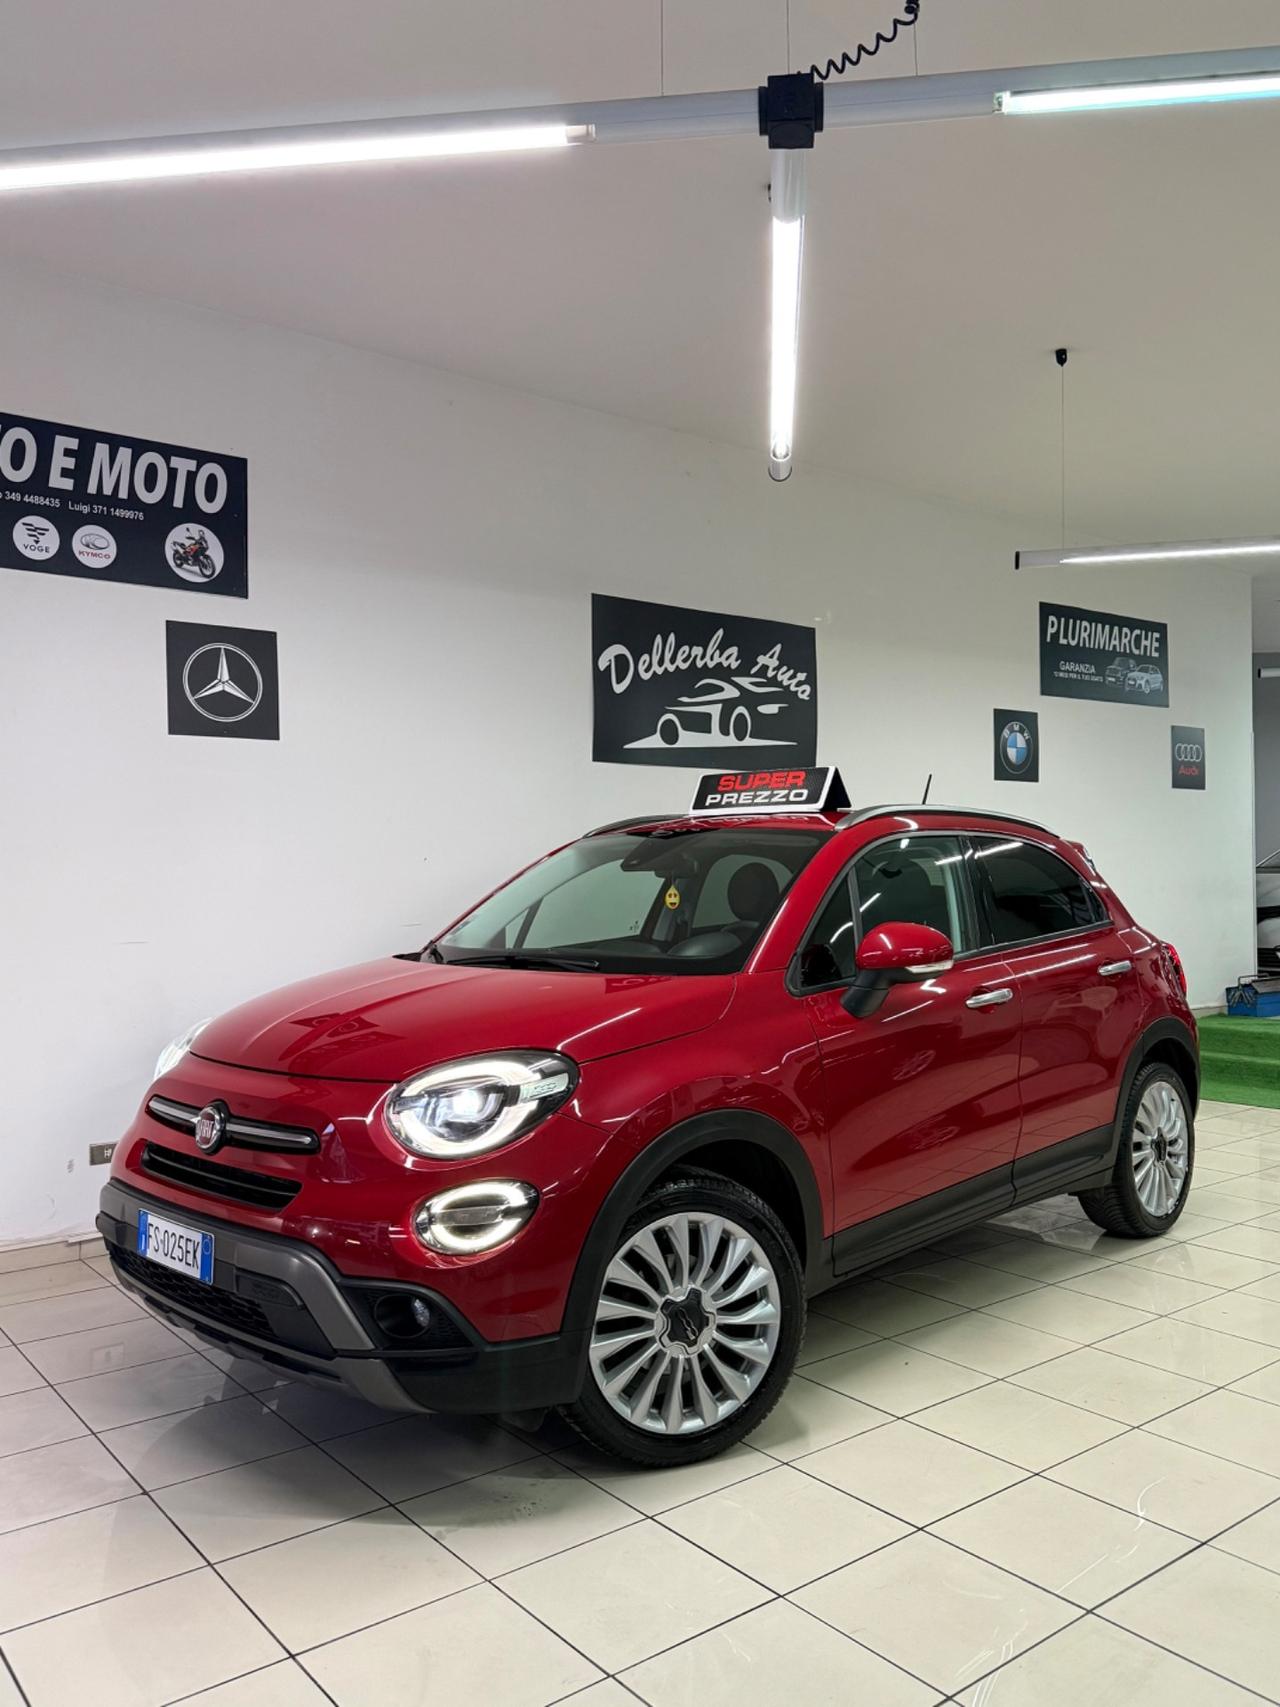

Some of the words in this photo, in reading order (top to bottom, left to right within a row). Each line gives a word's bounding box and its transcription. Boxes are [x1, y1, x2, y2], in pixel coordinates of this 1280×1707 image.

[0, 424, 37, 483] O
[48, 434, 79, 491] E
[87, 442, 228, 514] MOTO
[5, 491, 21, 501] 349
[23, 494, 61, 508] 4488435
[68, 501, 91, 514] Luigi
[92, 505, 108, 516] 371
[110, 508, 144, 521] 1499976
[23, 543, 50, 553] VOGE
[78, 550, 111, 560] KYMCO
[1046, 615, 1160, 658] PLURIMARCHE
[598, 627, 742, 694] Dellerba
[750, 643, 812, 700] Auto
[1059, 660, 1096, 674] GARANZIA
[1003, 723, 1030, 740] BMW
[1178, 765, 1199, 776] Audi
[717, 770, 806, 791] SUPER
[705, 788, 809, 806] PREZZO
